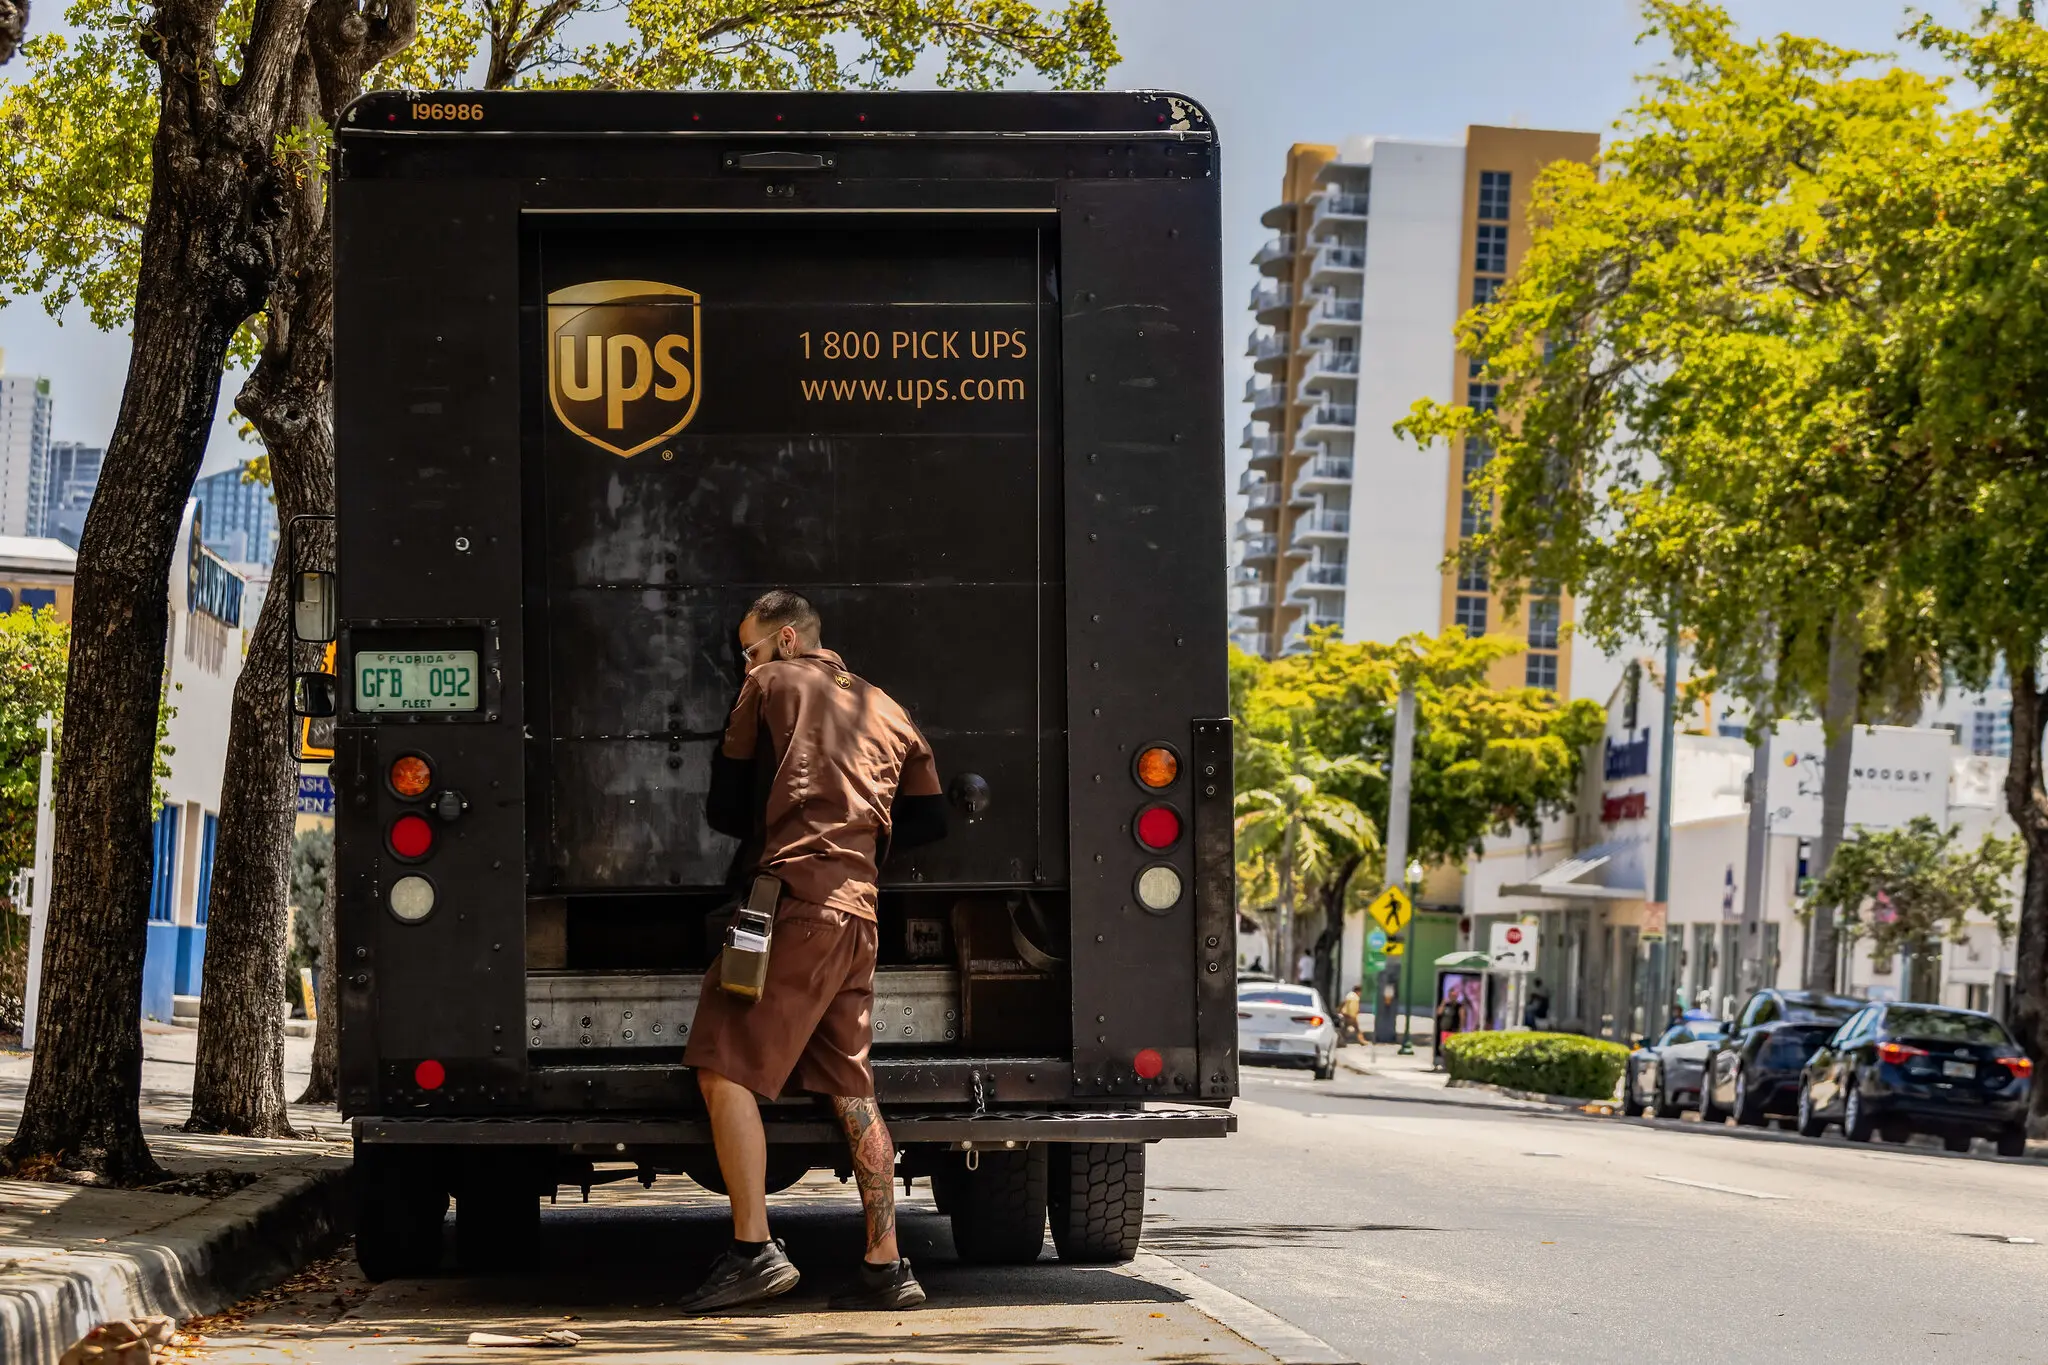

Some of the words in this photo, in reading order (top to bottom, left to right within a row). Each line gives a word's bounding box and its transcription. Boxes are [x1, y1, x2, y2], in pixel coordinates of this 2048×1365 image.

[412, 103, 484, 121] 196986
[799, 331, 810, 359] 1
[823, 331, 880, 359] 800
[892, 330, 960, 359] PICK
[970, 330, 1027, 359] UPS
[560, 333, 692, 430] ups
[800, 378, 1025, 409] www.ups.com
[388, 654, 445, 664] FLORIDA
[362, 668, 403, 698] GFB
[429, 667, 470, 697] 092
[402, 699, 432, 709] FLEET
[297, 777, 326, 794] ASH,
[297, 796, 326, 812] PEN
